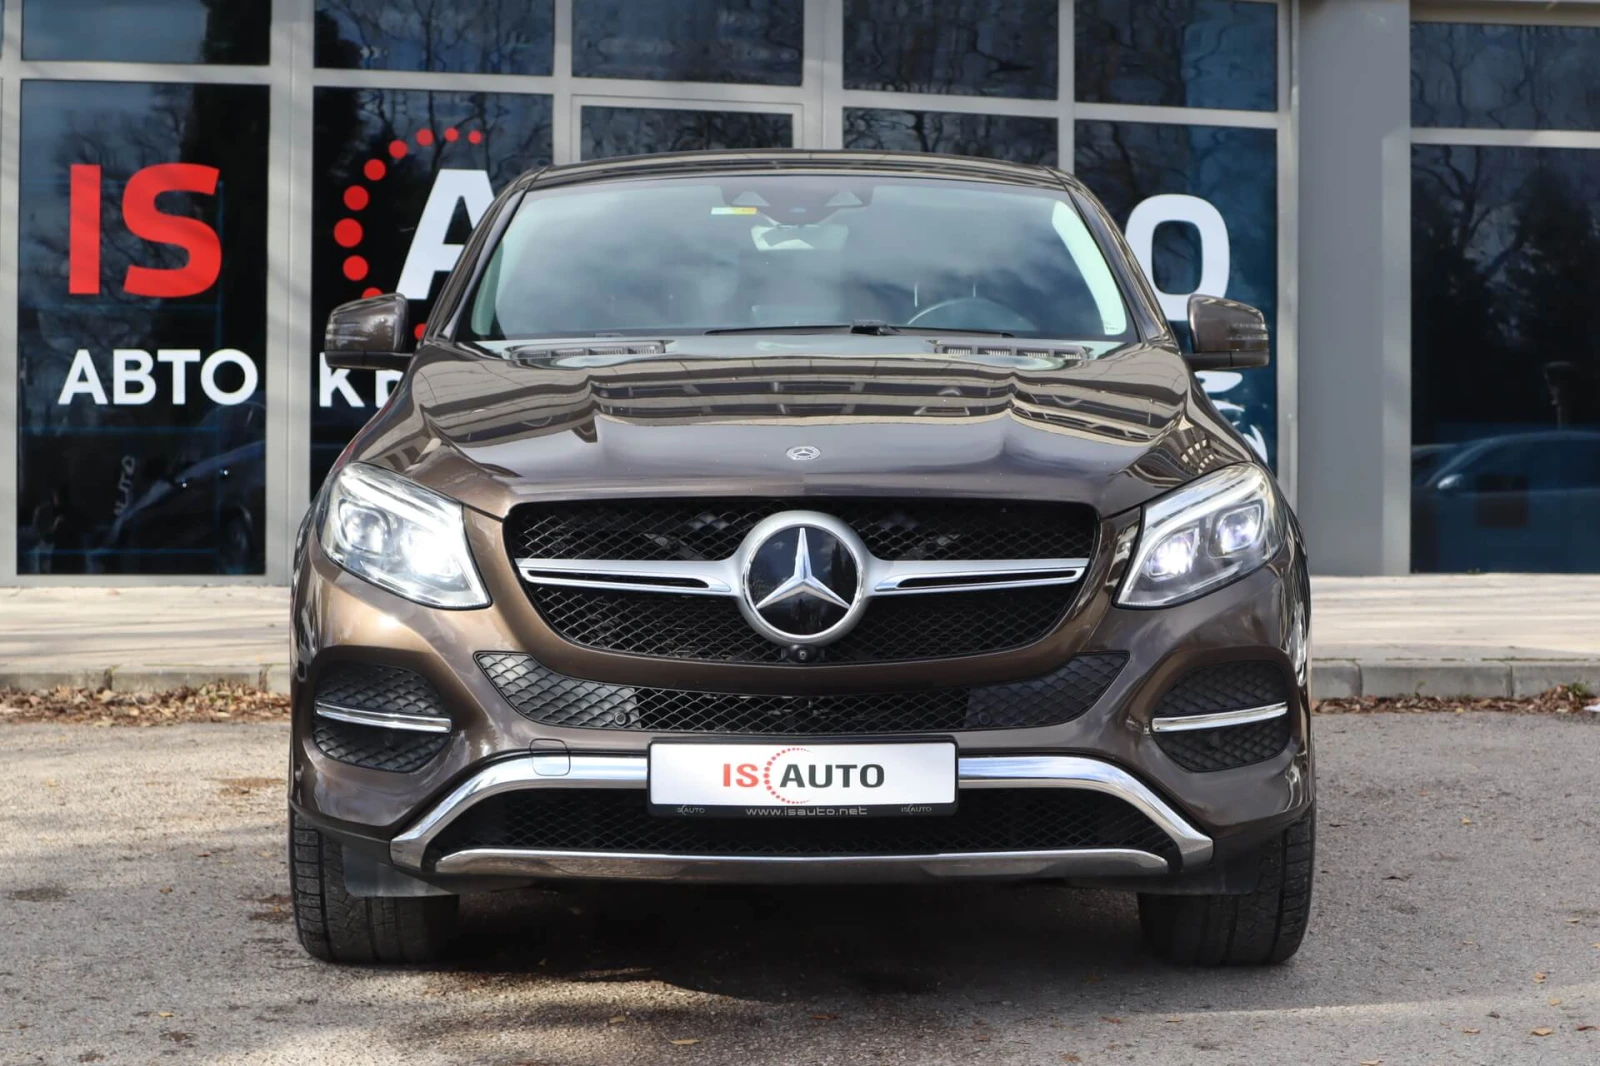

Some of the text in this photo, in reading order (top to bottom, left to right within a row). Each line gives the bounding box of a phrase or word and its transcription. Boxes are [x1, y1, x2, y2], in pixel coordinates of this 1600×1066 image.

[69, 162, 222, 298] IS
[58, 348, 258, 405] АВТО
[723, 763, 885, 788] IS AUTO
[745, 806, 868, 816] www.isauto.net
